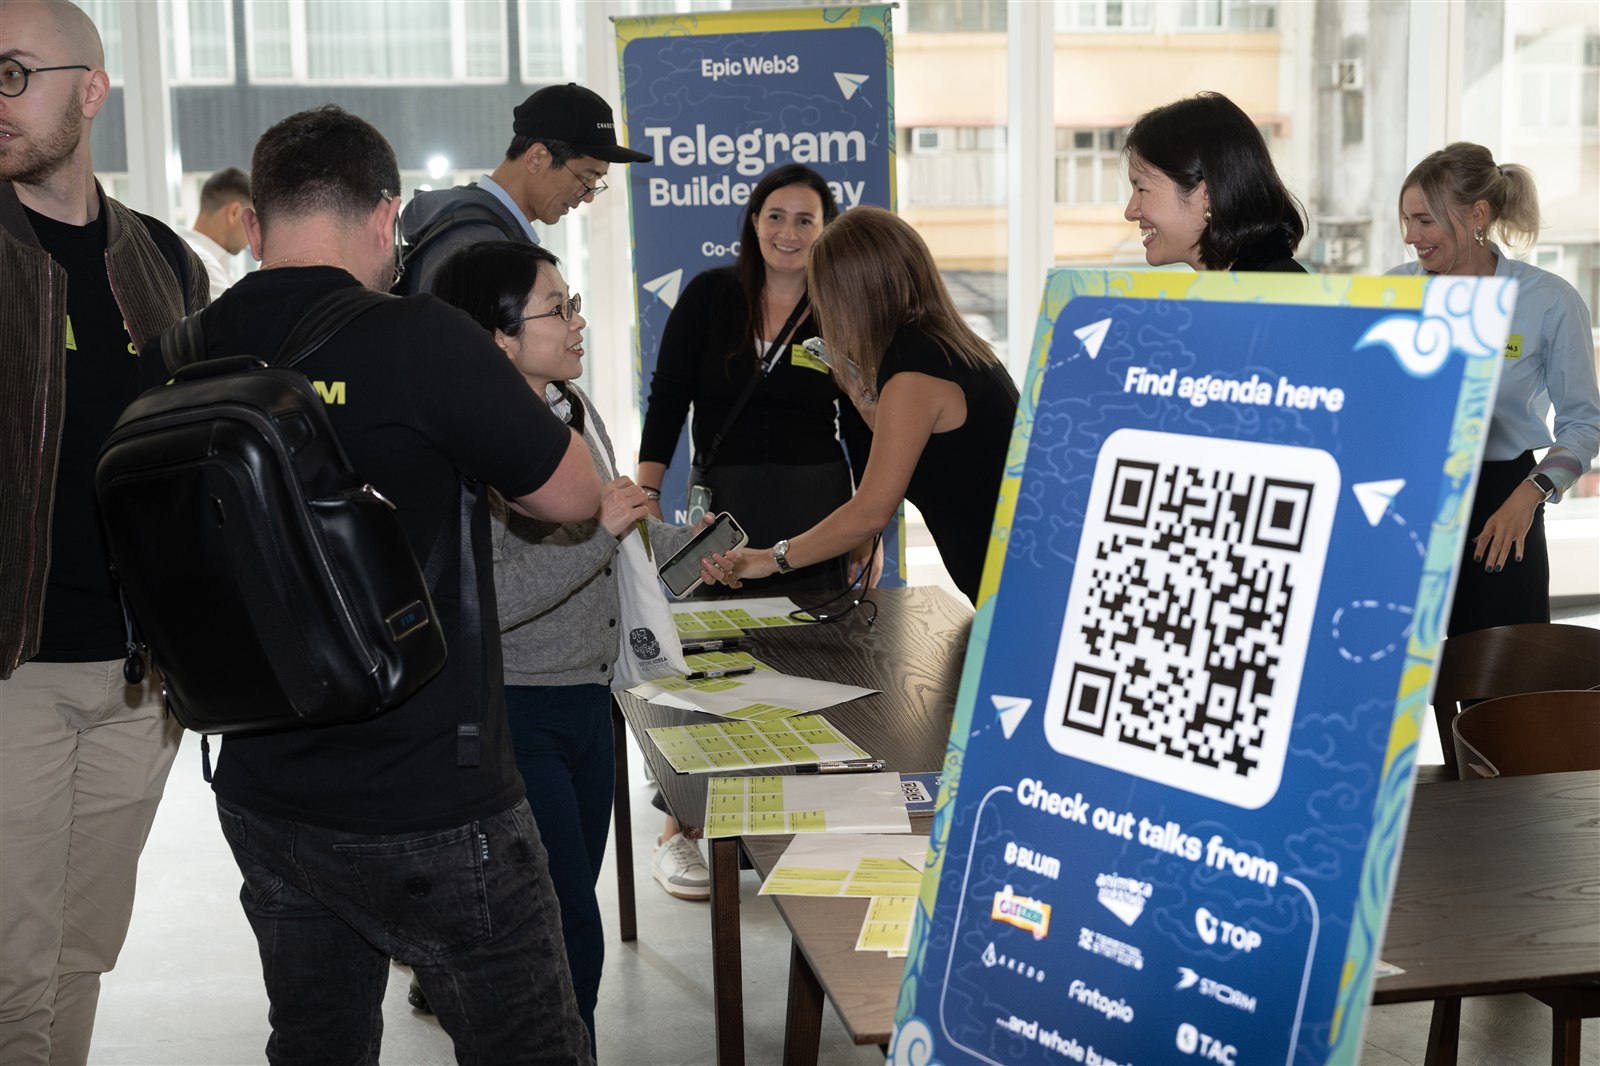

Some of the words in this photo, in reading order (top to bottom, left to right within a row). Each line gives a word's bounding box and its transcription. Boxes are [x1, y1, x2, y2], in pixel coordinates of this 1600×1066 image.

[701, 58, 742, 81] Epic
[742, 55, 800, 75] Web3
[644, 123, 867, 176] Telegram
[649, 175, 756, 207] Builde
[832, 180, 866, 210] ay
[1123, 366, 1177, 396] Find
[1177, 374, 1273, 408] agenda
[1274, 376, 1345, 412] here
[1016, 777, 1091, 825] Check
[1091, 806, 1137, 840] out
[1138, 817, 1203, 862] talks
[1205, 835, 1279, 887] from
[1220, 920, 1262, 953] TOP
[998, 953, 1046, 983] AKEDO
[1198, 977, 1257, 1014] STORM
[1039, 1028, 1085, 1063] whole
[1199, 1033, 1238, 1066] TAC
